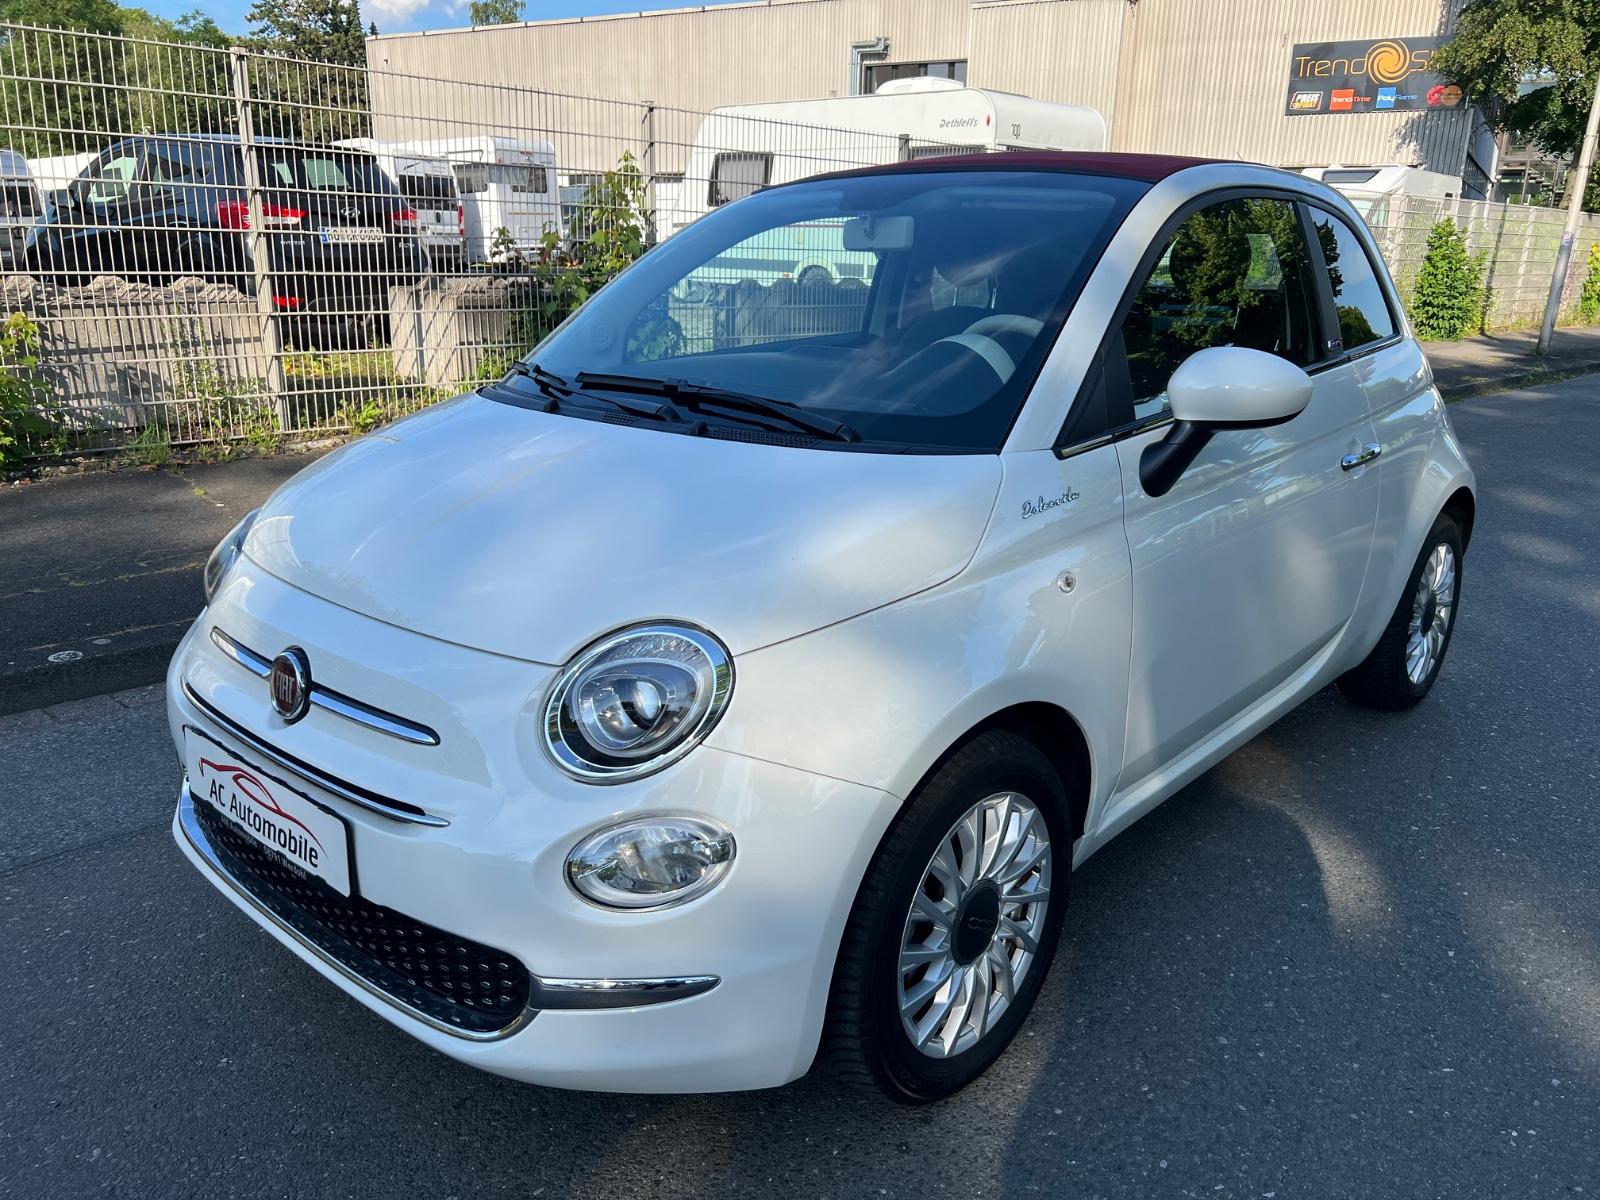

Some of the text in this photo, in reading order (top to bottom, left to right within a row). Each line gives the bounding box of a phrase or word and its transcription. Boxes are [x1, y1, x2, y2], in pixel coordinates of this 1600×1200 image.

[939, 117, 979, 129] Dethleffs
[1021, 486, 1080, 520] Dolcevita
[276, 670, 295, 704] FIAT
[209, 778, 319, 869] AC Automobile
[281, 857, 307, 881] Werdohl
